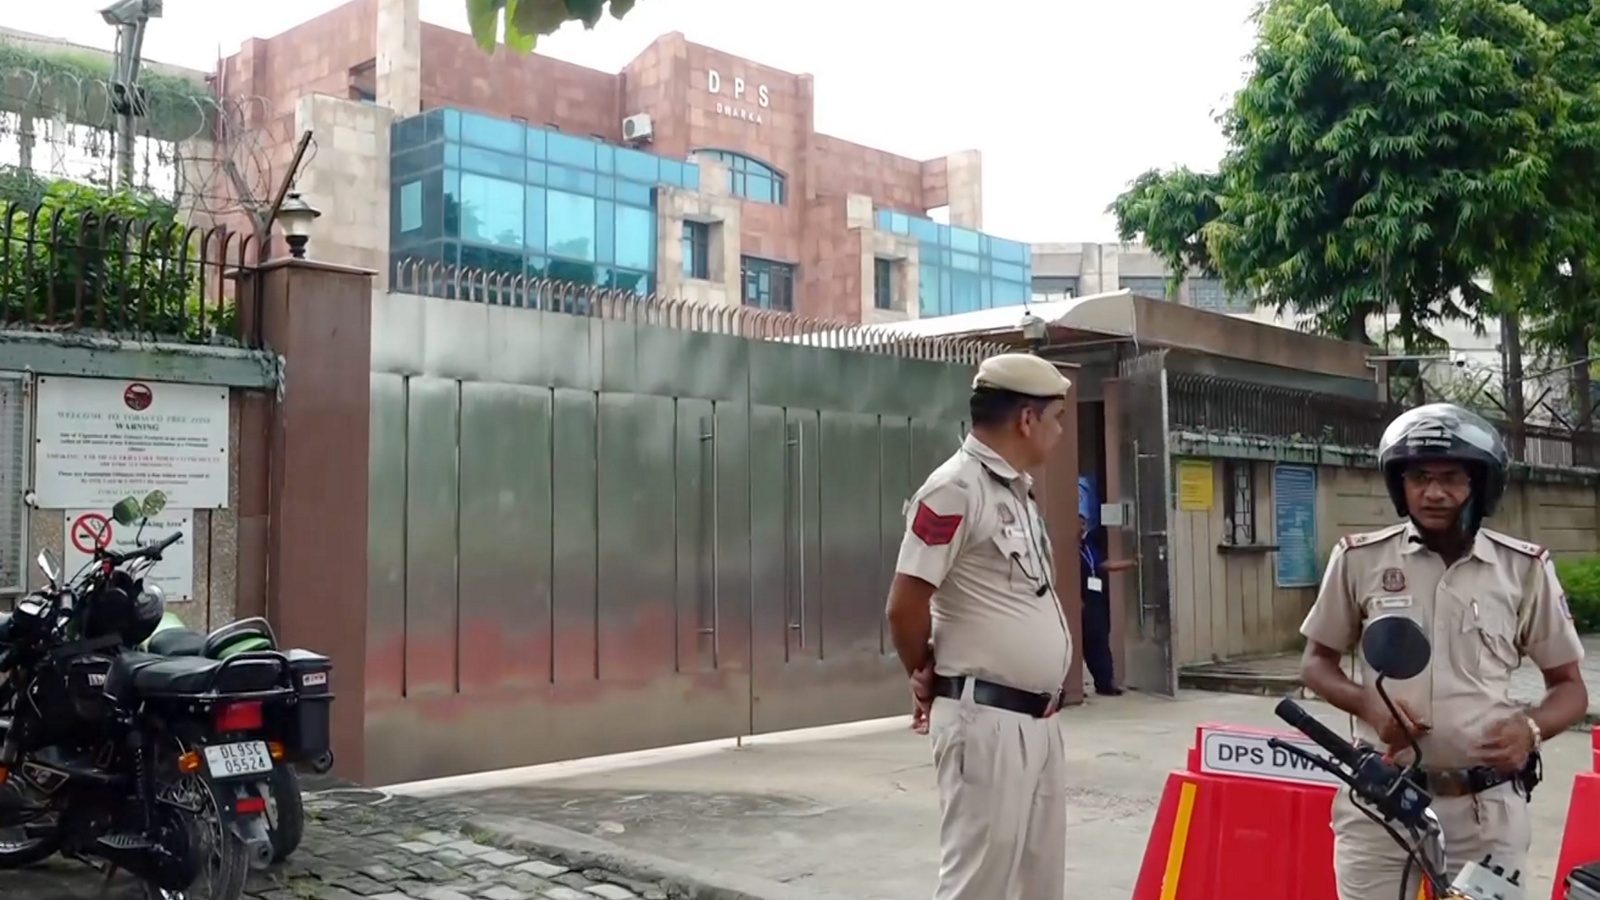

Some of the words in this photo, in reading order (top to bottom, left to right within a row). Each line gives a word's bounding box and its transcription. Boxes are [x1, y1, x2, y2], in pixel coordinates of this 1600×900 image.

[716, 102, 762, 123] DWARKA
[115, 423, 159, 431] WARNING
[220, 741, 262, 759] DL9SC
[1218, 743, 1265, 765] DPS
